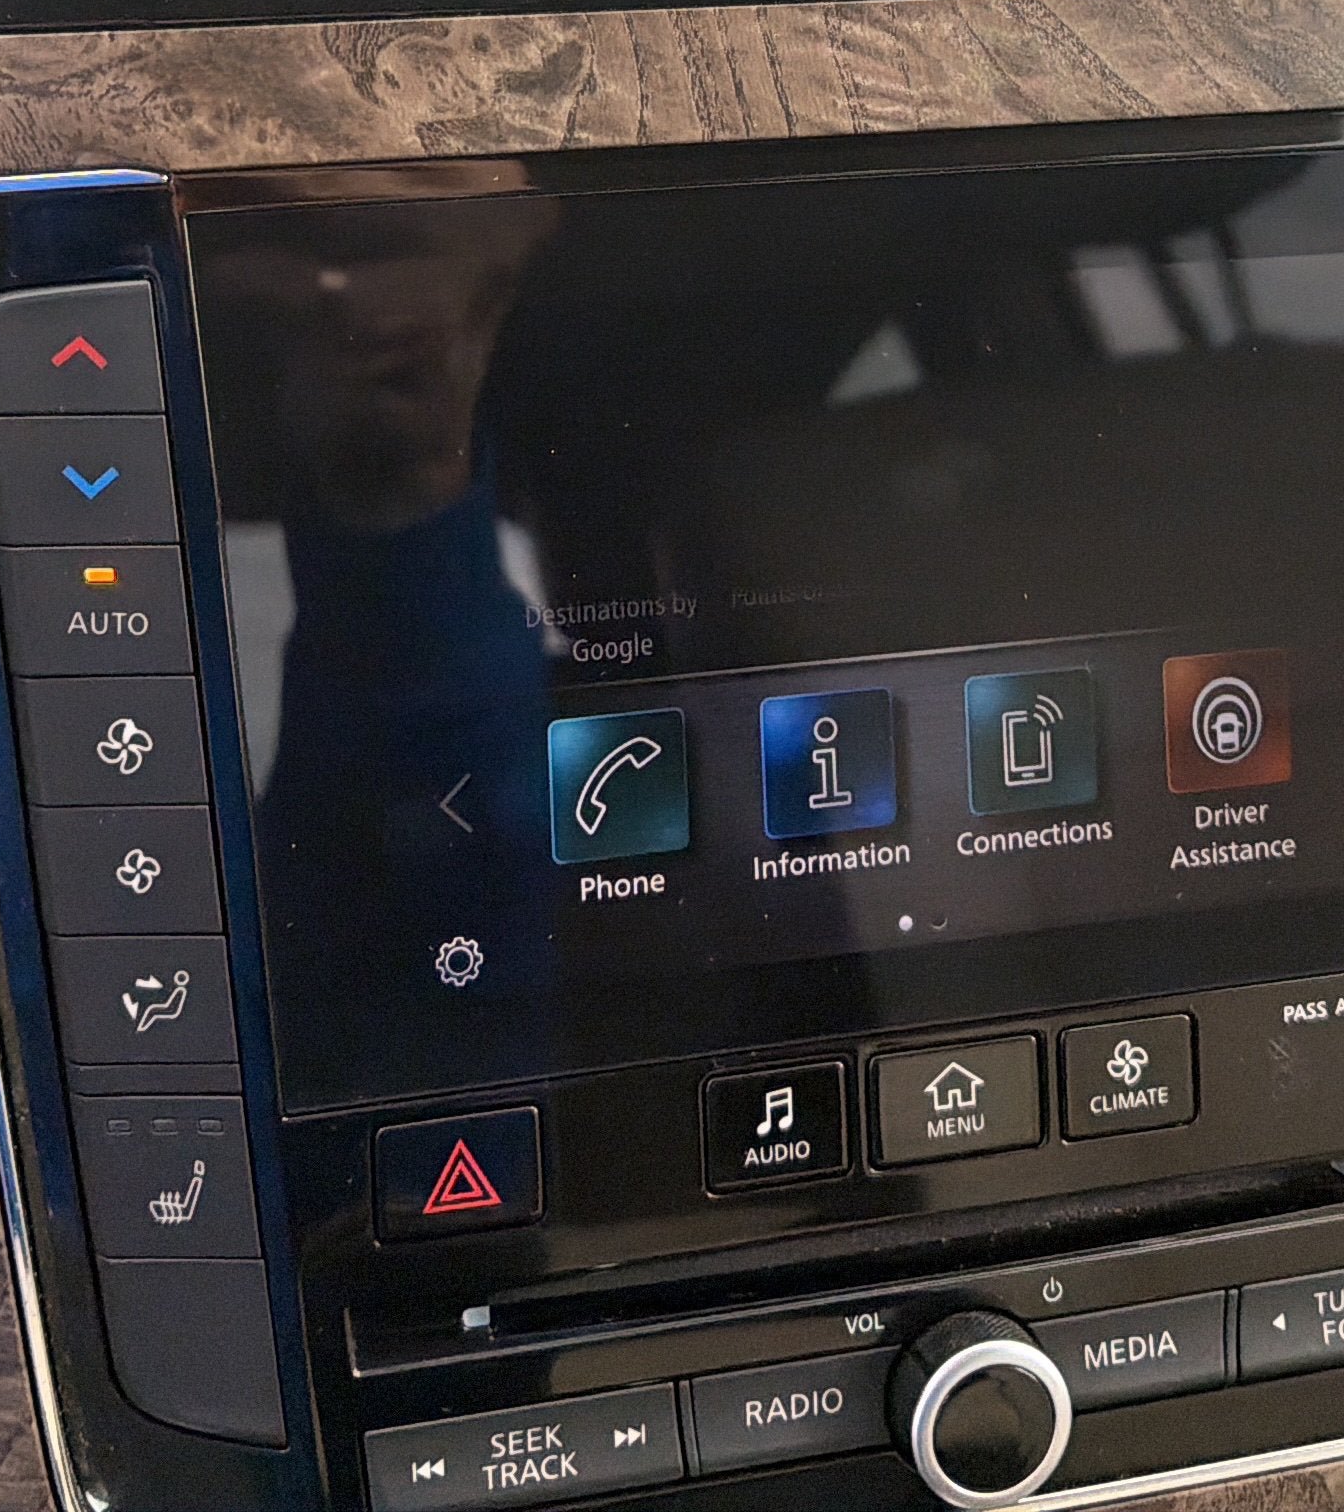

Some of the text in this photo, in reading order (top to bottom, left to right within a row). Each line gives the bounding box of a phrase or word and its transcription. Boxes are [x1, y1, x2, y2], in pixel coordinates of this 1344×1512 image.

[67, 611, 149, 637] AUTO
[525, 591, 698, 629] Destinations by
[572, 632, 654, 664] Google
[1193, 800, 1270, 830] Driver
[956, 816, 1114, 858] Connections
[1170, 834, 1297, 871] Assistance
[752, 836, 911, 881] Information
[579, 869, 666, 904] Phone
[1283, 1000, 1328, 1024] PASS
[1089, 1085, 1170, 1115] CLIMATE
[926, 1113, 986, 1140] MENU
[744, 1140, 812, 1167] AUDIO
[844, 1312, 885, 1335] VOL
[1082, 1330, 1179, 1370] MEDIA
[744, 1387, 844, 1427] RADIO
[489, 1423, 564, 1459] SEEK
[481, 1451, 579, 1491] TRACK
